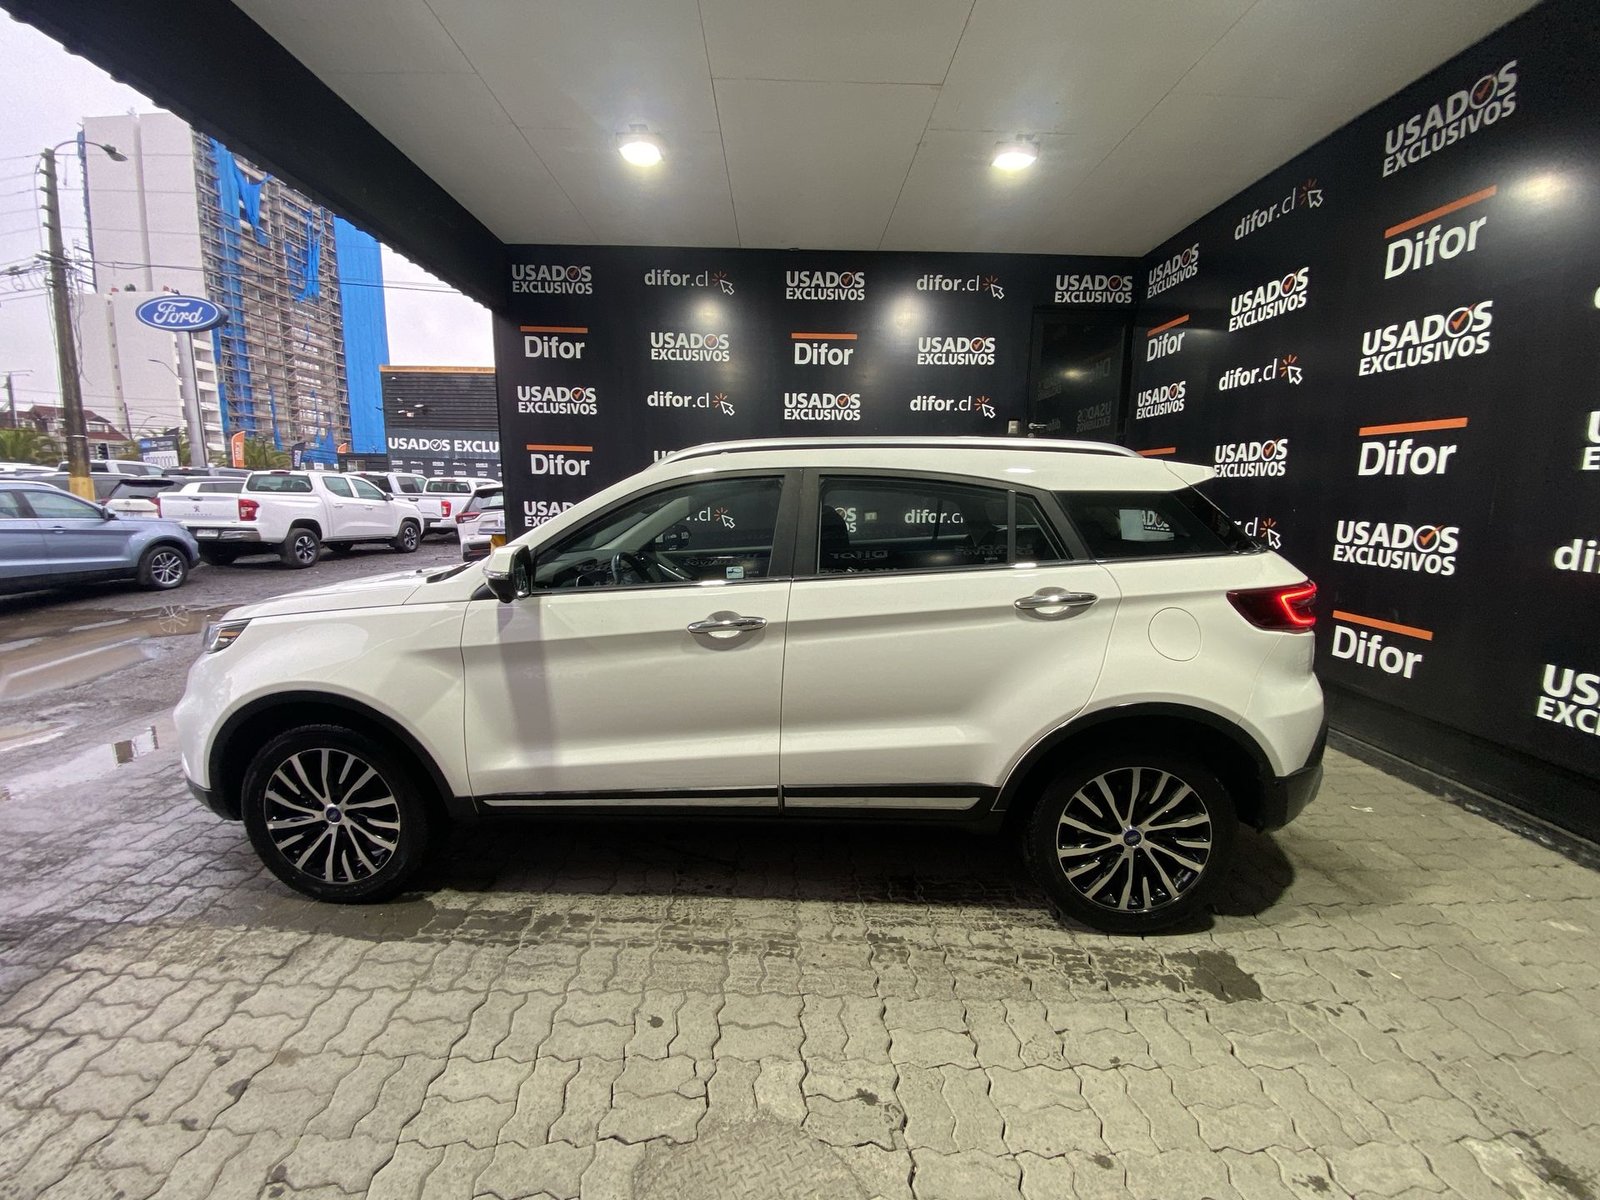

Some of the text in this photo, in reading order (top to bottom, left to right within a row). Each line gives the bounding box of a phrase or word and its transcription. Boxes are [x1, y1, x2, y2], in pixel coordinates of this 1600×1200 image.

[1385, 60, 1517, 154] USADOS
[1383, 92, 1516, 178] EXCLUSIVOS
[1234, 187, 1297, 240] difor.cl
[1385, 216, 1487, 280] Difor
[511, 264, 591, 282] USADOS
[1148, 243, 1200, 286] USADOS
[512, 280, 593, 295] EXCLUSIVOS
[644, 270, 709, 287] difor.cl
[786, 270, 865, 289] USADOS
[916, 274, 980, 292] difor.cl
[1055, 274, 1133, 293] USADOS
[1147, 264, 1198, 299] EXCLUSIVOS
[785, 287, 865, 301] EXCLUSIVOS
[1054, 291, 1133, 304] EXCLUSIVOS
[1230, 266, 1310, 316] USADOS
[153, 301, 204, 324] Ford
[1228, 290, 1307, 332] EXCLUSIVOS
[1362, 300, 1493, 355] USADOS
[524, 335, 585, 359] Difor
[650, 332, 729, 350] USADOS
[918, 336, 996, 354] USADOS
[1147, 330, 1185, 362] Difor
[650, 348, 730, 362] EXCLUSIVOS
[794, 342, 854, 366] Difor
[917, 353, 995, 366] EXCLUSIVOS
[1359, 332, 1491, 376] EXCLUSIVOS
[1218, 358, 1277, 392] difor.cl
[517, 385, 597, 403] USADOS
[647, 391, 710, 409] difor.cl
[784, 392, 861, 410] USADOS
[909, 395, 971, 412] difor.cl
[1137, 380, 1187, 407] USADOS
[518, 401, 598, 415] EXCLUSIVOS
[784, 408, 860, 421] EXCLUSIVOS
[1136, 399, 1185, 420] EXCLUSIVOS
[388, 437, 451, 451] USADOS
[1214, 438, 1288, 463] USADOS
[530, 453, 590, 475] Difor
[1214, 457, 1286, 477] EXCLUSIVOS
[1358, 438, 1456, 476] Difor
[1336, 520, 1459, 554] USADOS
[1333, 544, 1456, 576] EXCLUSIVOS
[1554, 539, 1600, 573] di
[1332, 625, 1423, 679] Difor
[1542, 664, 1600, 709] US
